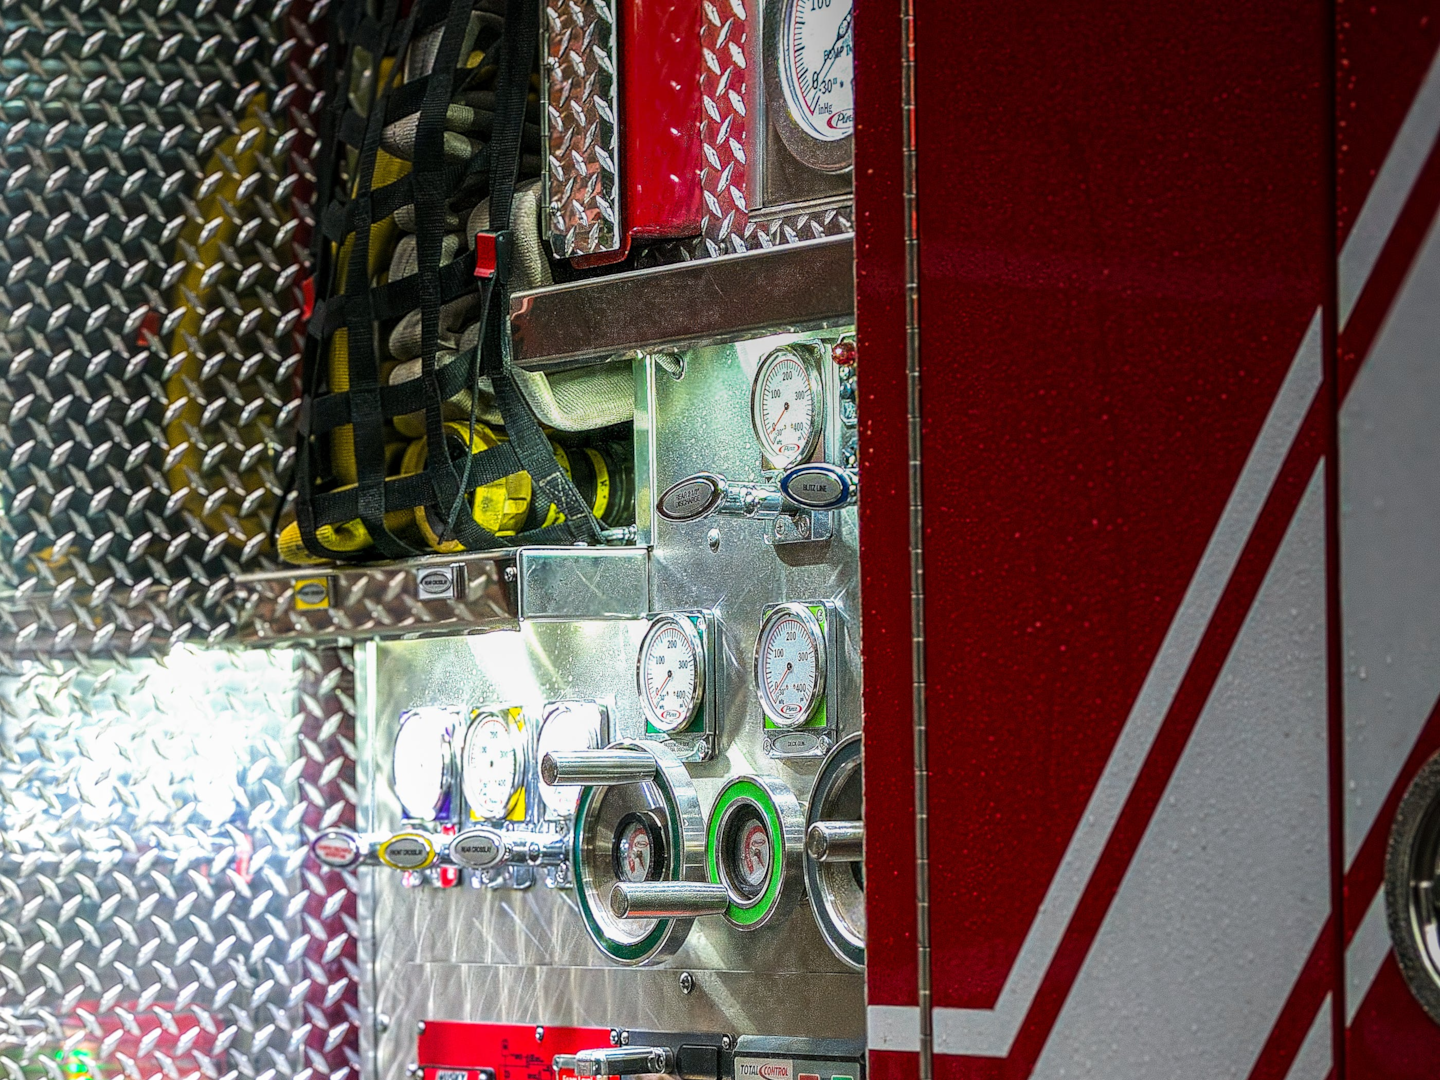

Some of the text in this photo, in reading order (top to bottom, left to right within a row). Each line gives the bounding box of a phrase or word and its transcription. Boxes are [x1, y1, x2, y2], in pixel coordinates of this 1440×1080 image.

[782, 371, 793, 381] 200
[770, 389, 781, 399] 100
[794, 391, 806, 401] 300
[793, 422, 804, 432] 400
[803, 484, 827, 493] BLITZ LINE
[785, 631, 797, 641] 200
[667, 640, 678, 649] 200
[773, 648, 784, 658] 100
[798, 651, 809, 662] 300
[655, 656, 665, 665] 100
[678, 660, 689, 669] 300
[796, 683, 807, 693] 400
[676, 690, 686, 699] 400
[740, 1064, 789, 1077] TOTAL CONTROL
